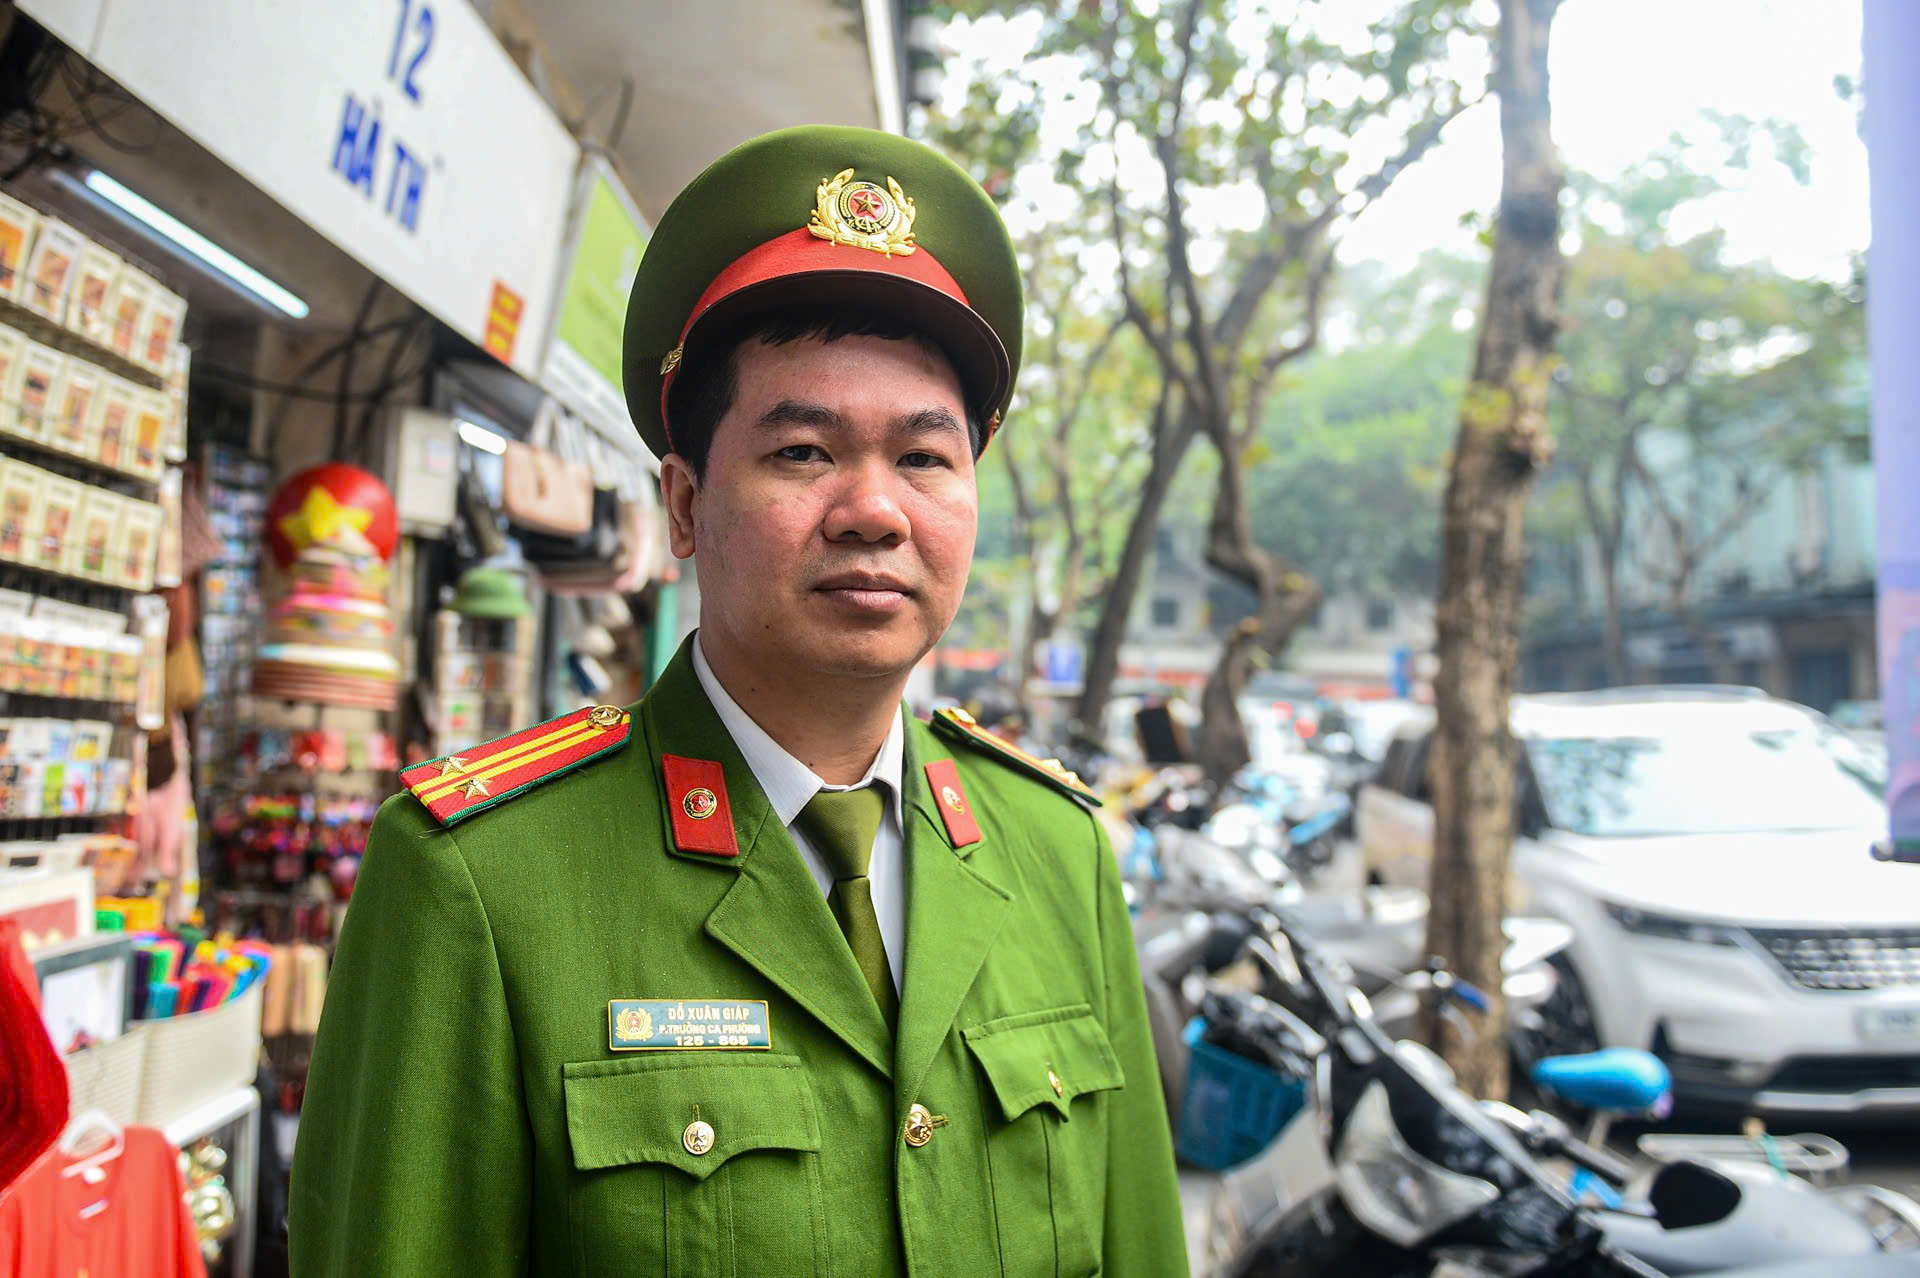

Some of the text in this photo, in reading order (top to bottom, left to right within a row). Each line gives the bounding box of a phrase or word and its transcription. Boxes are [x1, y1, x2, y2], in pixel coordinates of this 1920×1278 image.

[688, 1005, 721, 1020] XUÂN
[723, 1005, 750, 1020] GIÁP
[707, 1024, 722, 1034] CA
